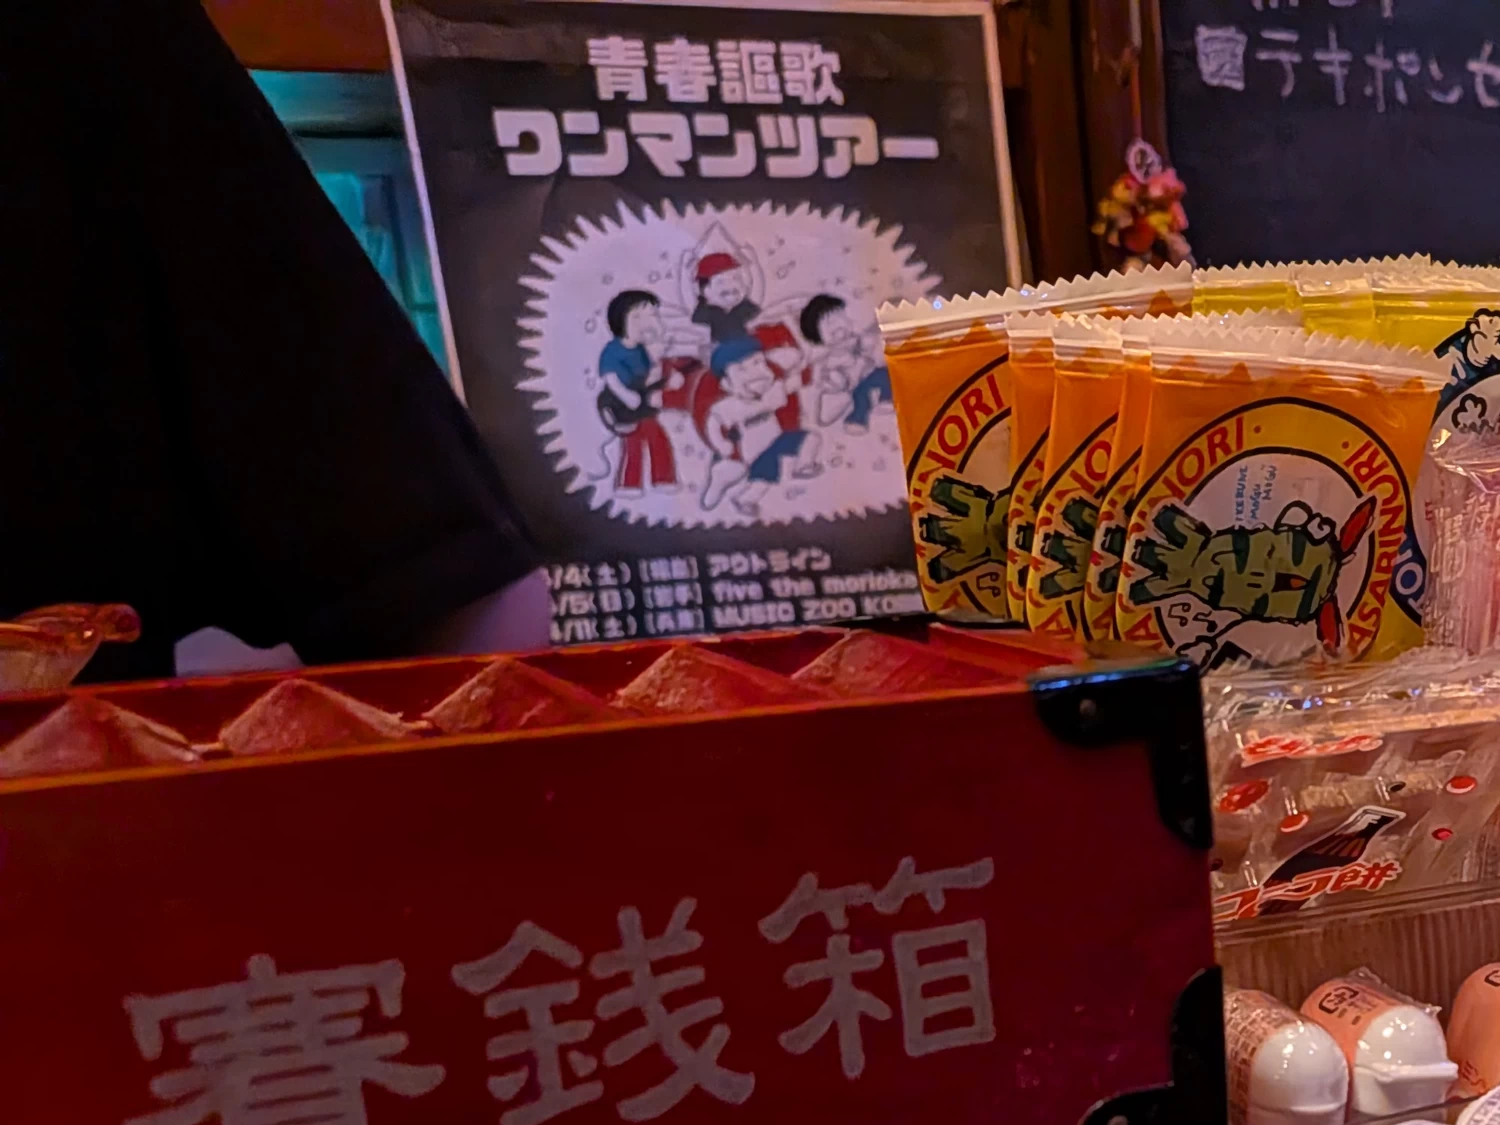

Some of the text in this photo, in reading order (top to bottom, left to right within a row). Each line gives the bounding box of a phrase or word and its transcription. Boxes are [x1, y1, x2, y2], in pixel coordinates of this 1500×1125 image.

[587, 37, 845, 106] 青春謳歌
[492, 109, 939, 179] ワンマンツアー
[1213, 861, 1400, 920] コーラ餅
